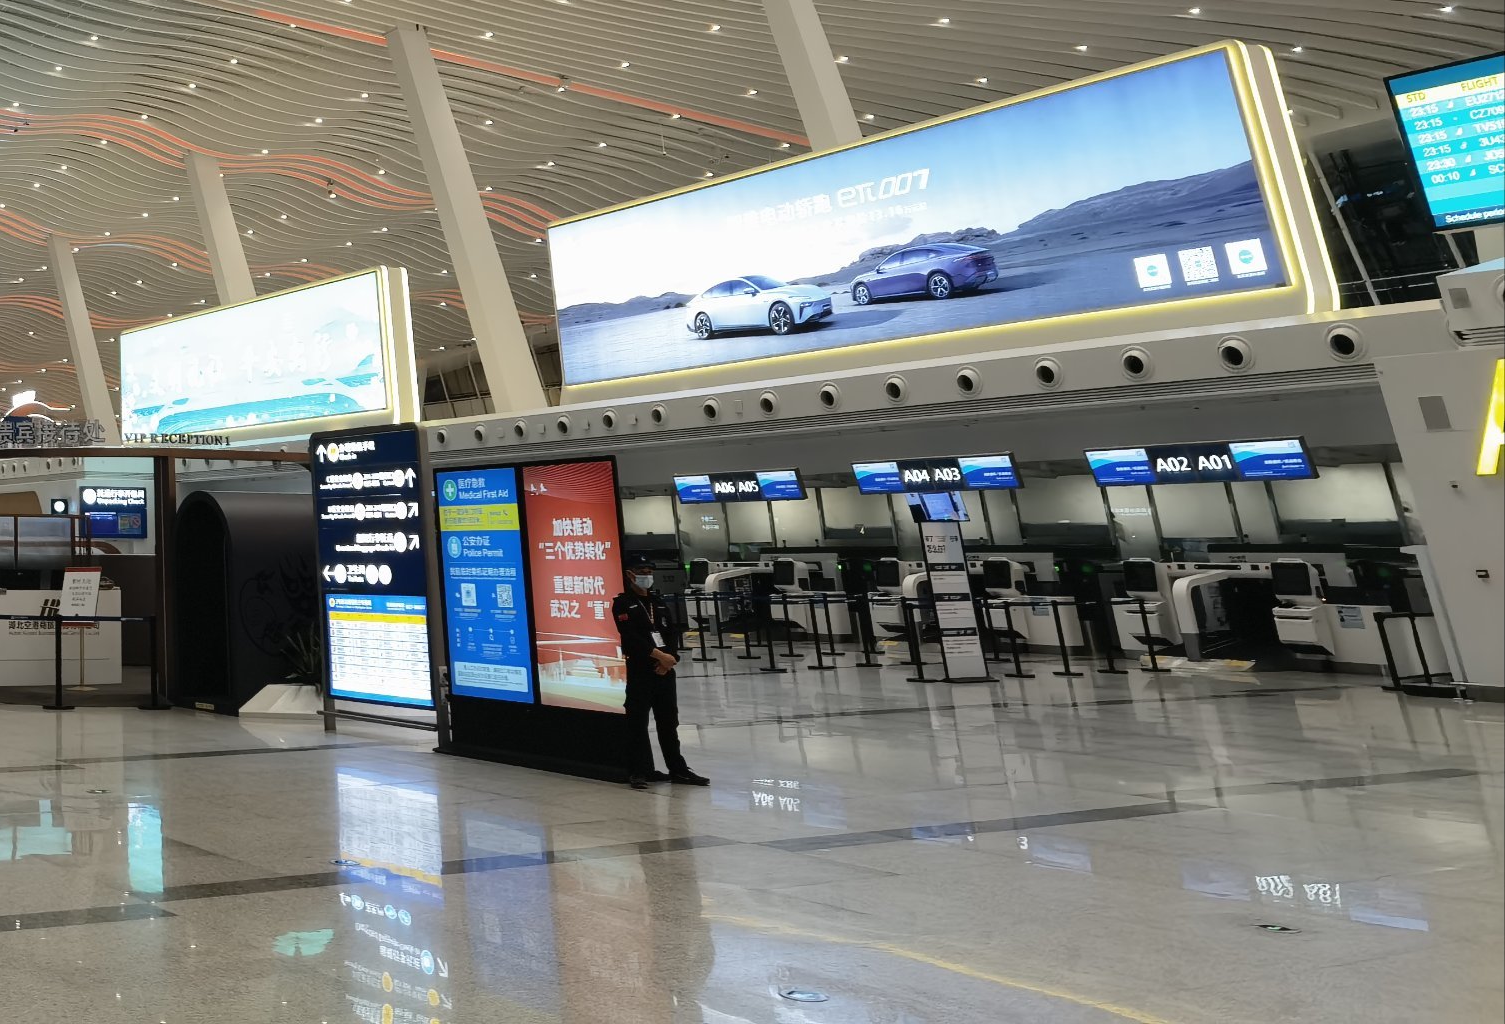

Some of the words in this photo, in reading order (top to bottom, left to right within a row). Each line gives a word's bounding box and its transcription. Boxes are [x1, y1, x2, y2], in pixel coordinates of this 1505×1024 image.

[1406, 92, 1426, 103] STD
[1461, 76, 1499, 92] FLIGHT
[1414, 117, 1443, 130] 23:15
[1423, 144, 1451, 157] 23:15
[124, 433, 147, 444] VIP
[150, 433, 223, 446] RECEPTION
[225, 436, 232, 446] 1
[1156, 456, 1192, 473] A02
[1197, 454, 1233, 471] A01
[904, 469, 931, 483] A04
[934, 467, 961, 481] A03
[714, 481, 736, 494] A06
[738, 480, 759, 492] A05
[459, 490, 483, 500] Medical
[483, 490, 497, 499] First
[498, 489, 509, 498] Aid
[553, 518, 593, 536] 加快推动
[463, 549, 481, 557] Police
[553, 576, 605, 595] 重塑新时代
